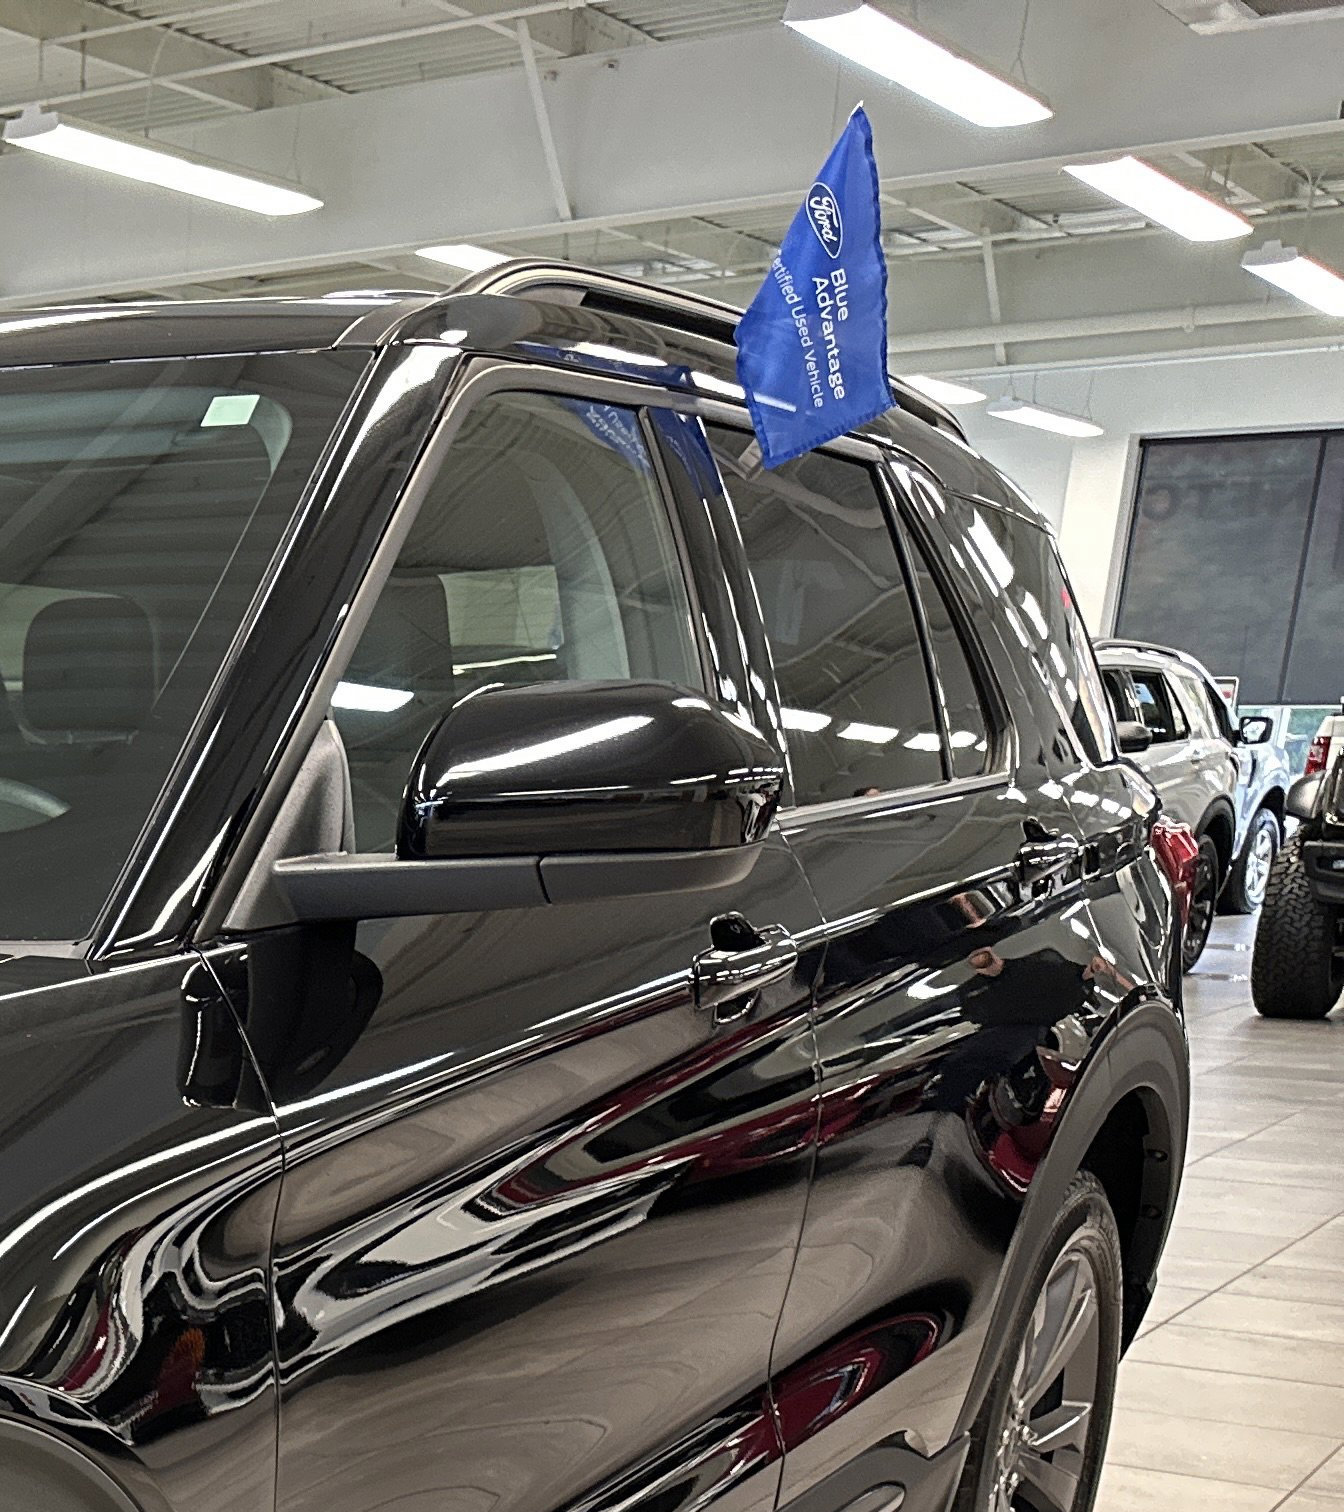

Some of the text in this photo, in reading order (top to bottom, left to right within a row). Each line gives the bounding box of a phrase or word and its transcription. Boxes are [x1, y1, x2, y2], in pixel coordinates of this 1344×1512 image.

[771, 249, 824, 408] ertified Used Vehicle
[812, 276, 846, 400] Advantage
[830, 268, 849, 322] Blue
